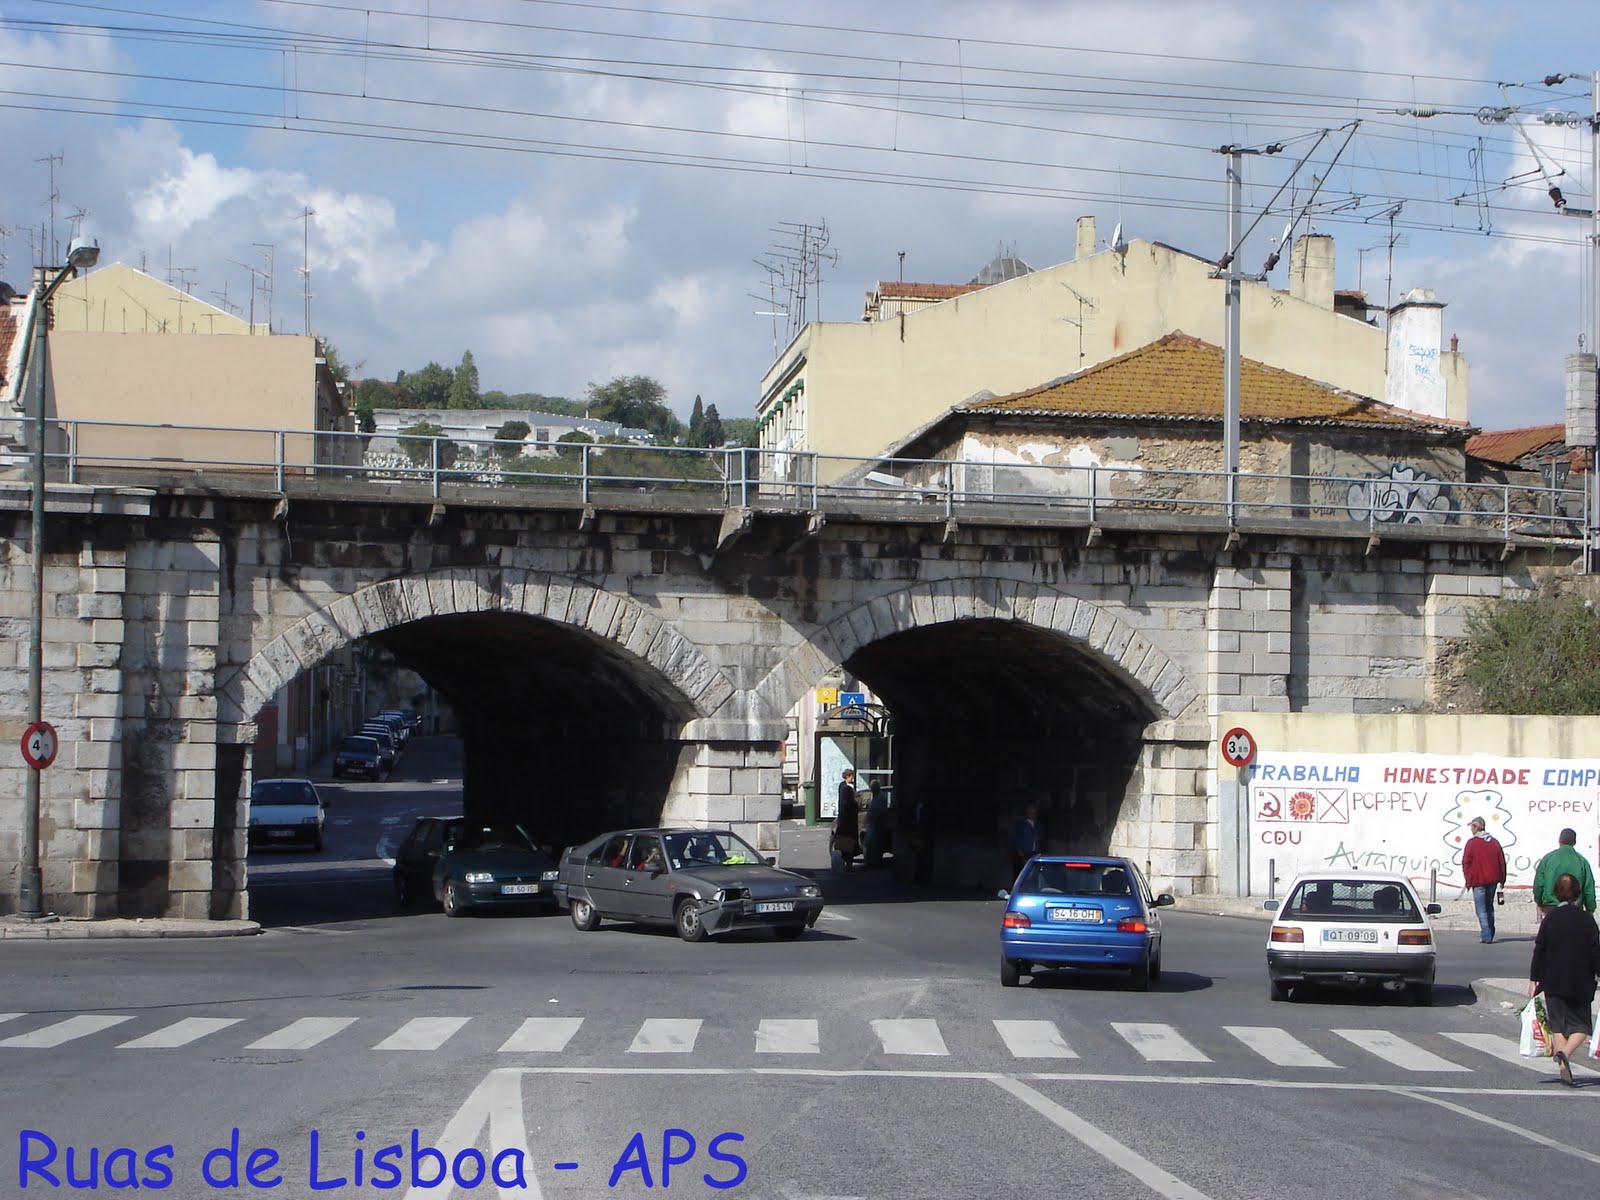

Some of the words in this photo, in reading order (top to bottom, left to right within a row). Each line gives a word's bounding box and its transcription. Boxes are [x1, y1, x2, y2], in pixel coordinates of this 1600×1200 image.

[1249, 764, 1360, 782] TRABALHO
[1383, 767, 1531, 786] HONESTIDADE
[1543, 769, 1600, 787] COMP
[1353, 791, 1428, 812] PCP-PEV
[1528, 800, 1593, 813] PCP-PEV
[1261, 830, 1302, 845] CDU
